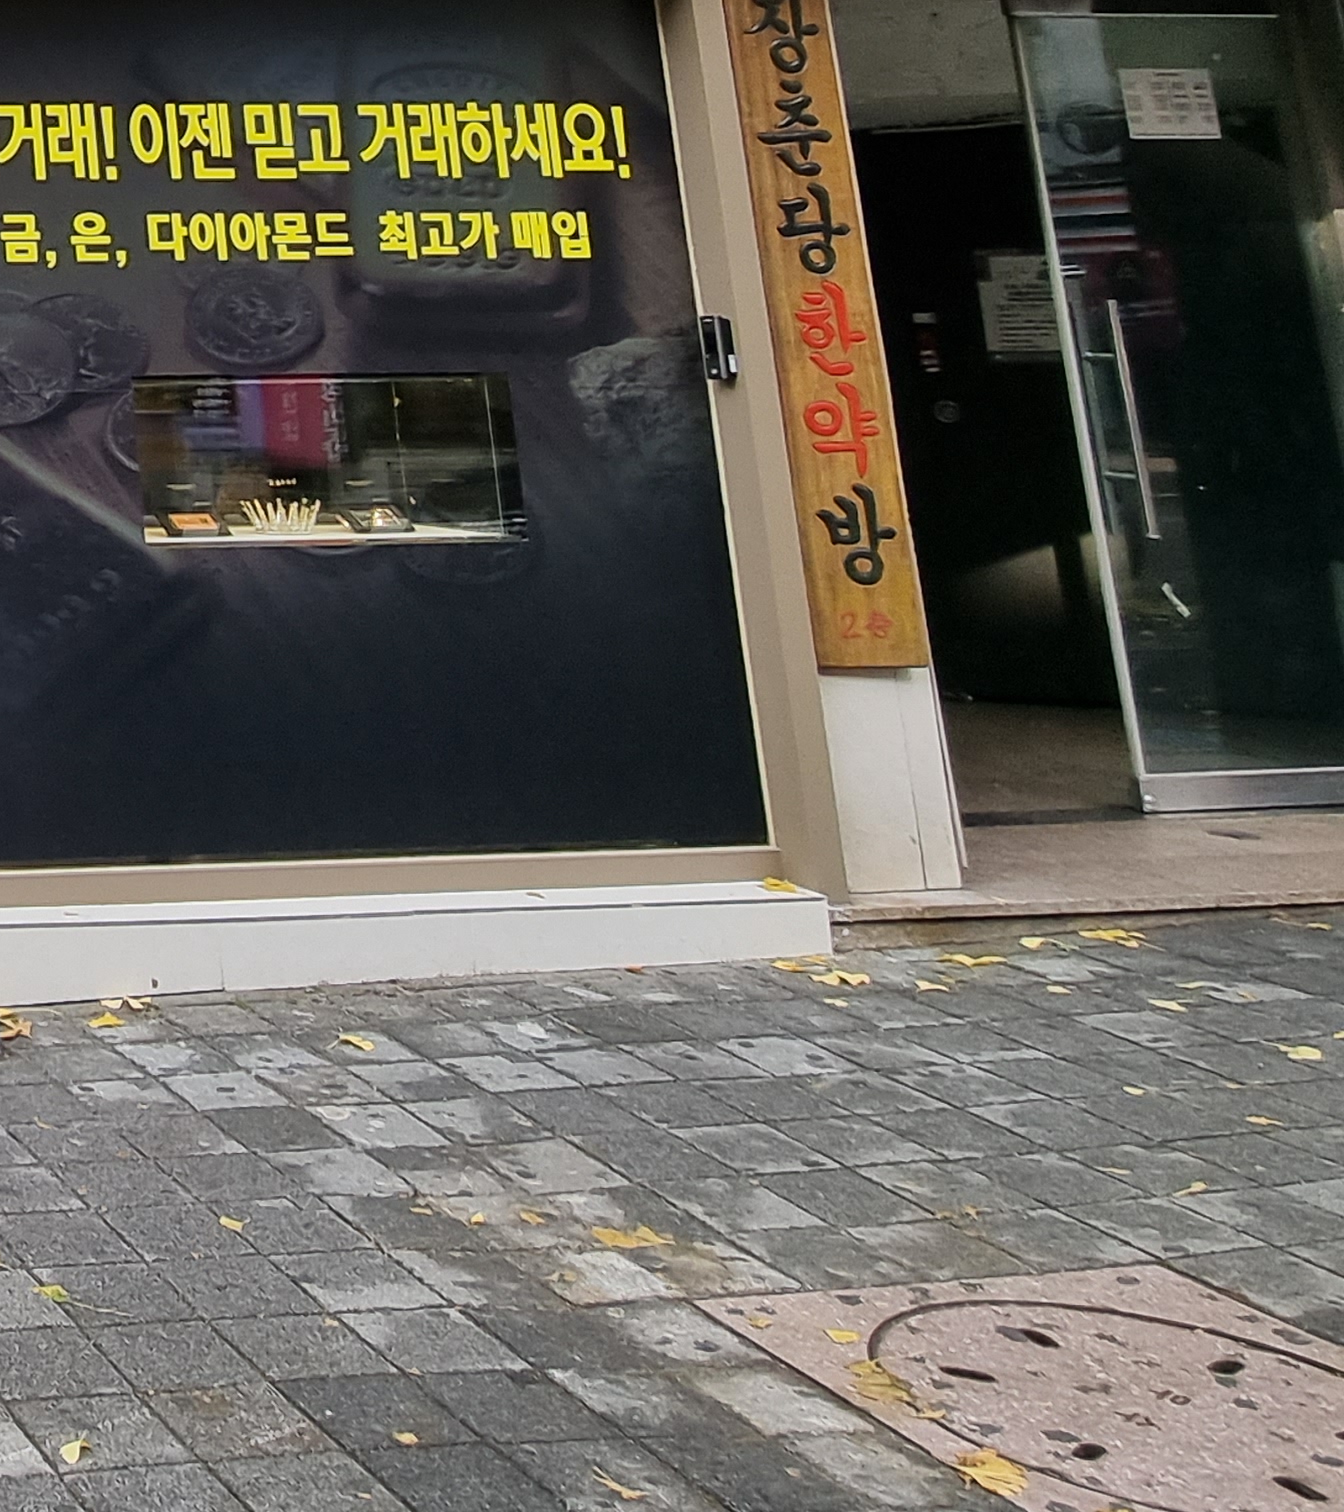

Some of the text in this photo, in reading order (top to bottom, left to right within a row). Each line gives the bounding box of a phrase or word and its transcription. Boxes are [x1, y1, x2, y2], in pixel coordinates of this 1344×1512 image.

[128, 102, 237, 181] 이젠
[243, 101, 351, 180] 믿고
[356, 101, 632, 180] 거래하세요!
[69, 210, 127, 269] 은,
[144, 210, 356, 263] 다이아몬드
[377, 210, 500, 261] 최고가
[510, 210, 592, 261] 매입
